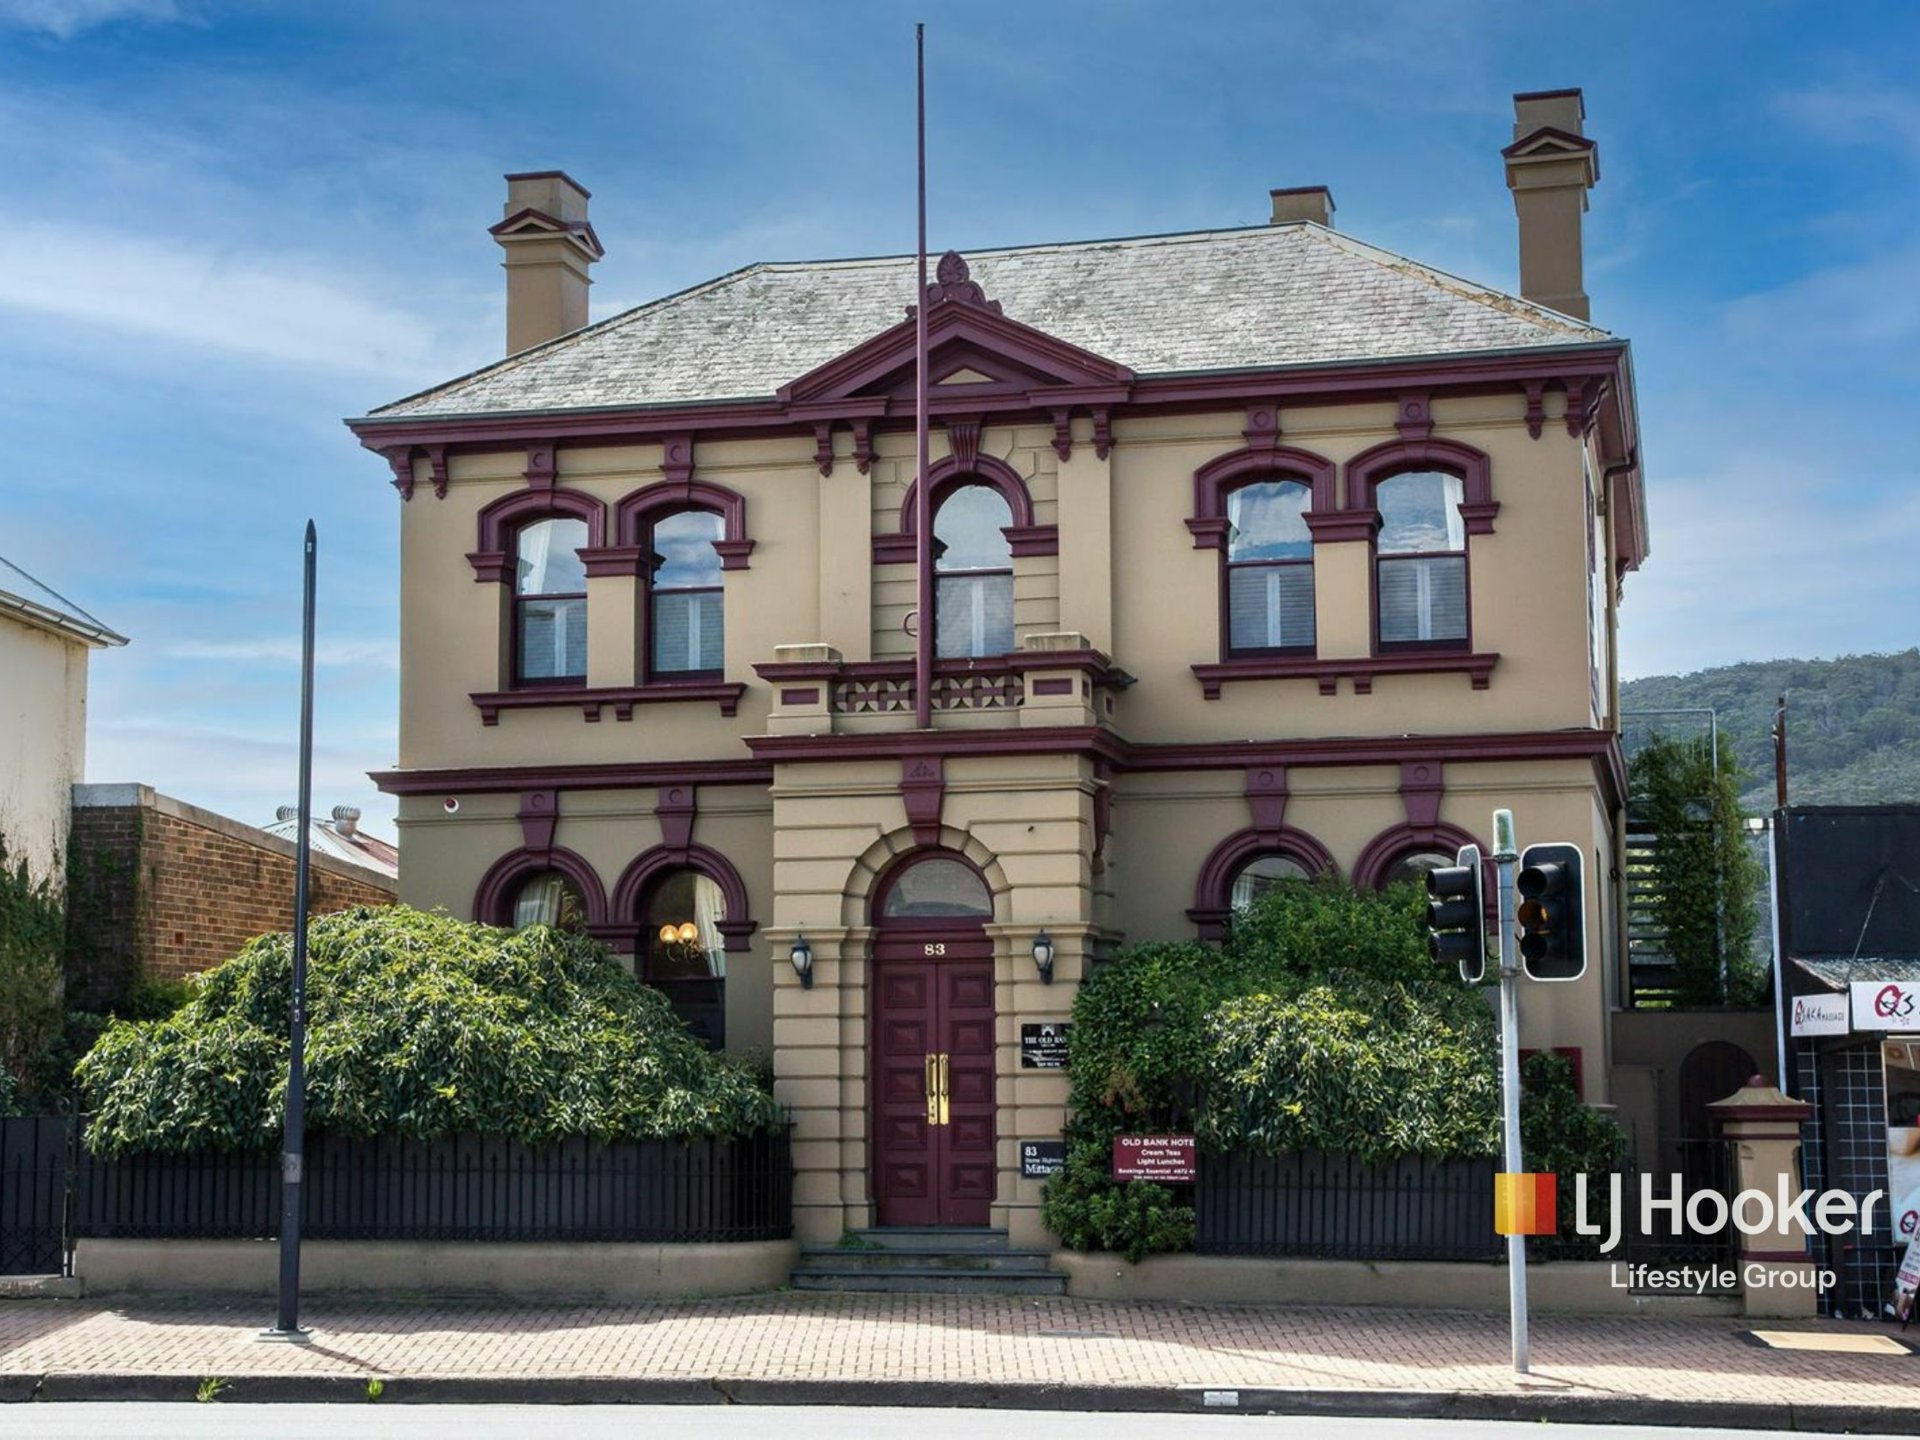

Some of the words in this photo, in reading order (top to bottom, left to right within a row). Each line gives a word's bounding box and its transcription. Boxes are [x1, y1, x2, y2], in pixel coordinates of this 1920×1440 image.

[924, 943, 945, 956] 83
[1024, 1036, 1037, 1045] THE
[1038, 1036, 1053, 1045] OLD
[1121, 1138, 1142, 1147] OLD
[1143, 1138, 1169, 1147] BANK
[1170, 1138, 1195, 1147] HOTE
[1025, 1146, 1038, 1157] 83
[1136, 1158, 1155, 1166] Light
